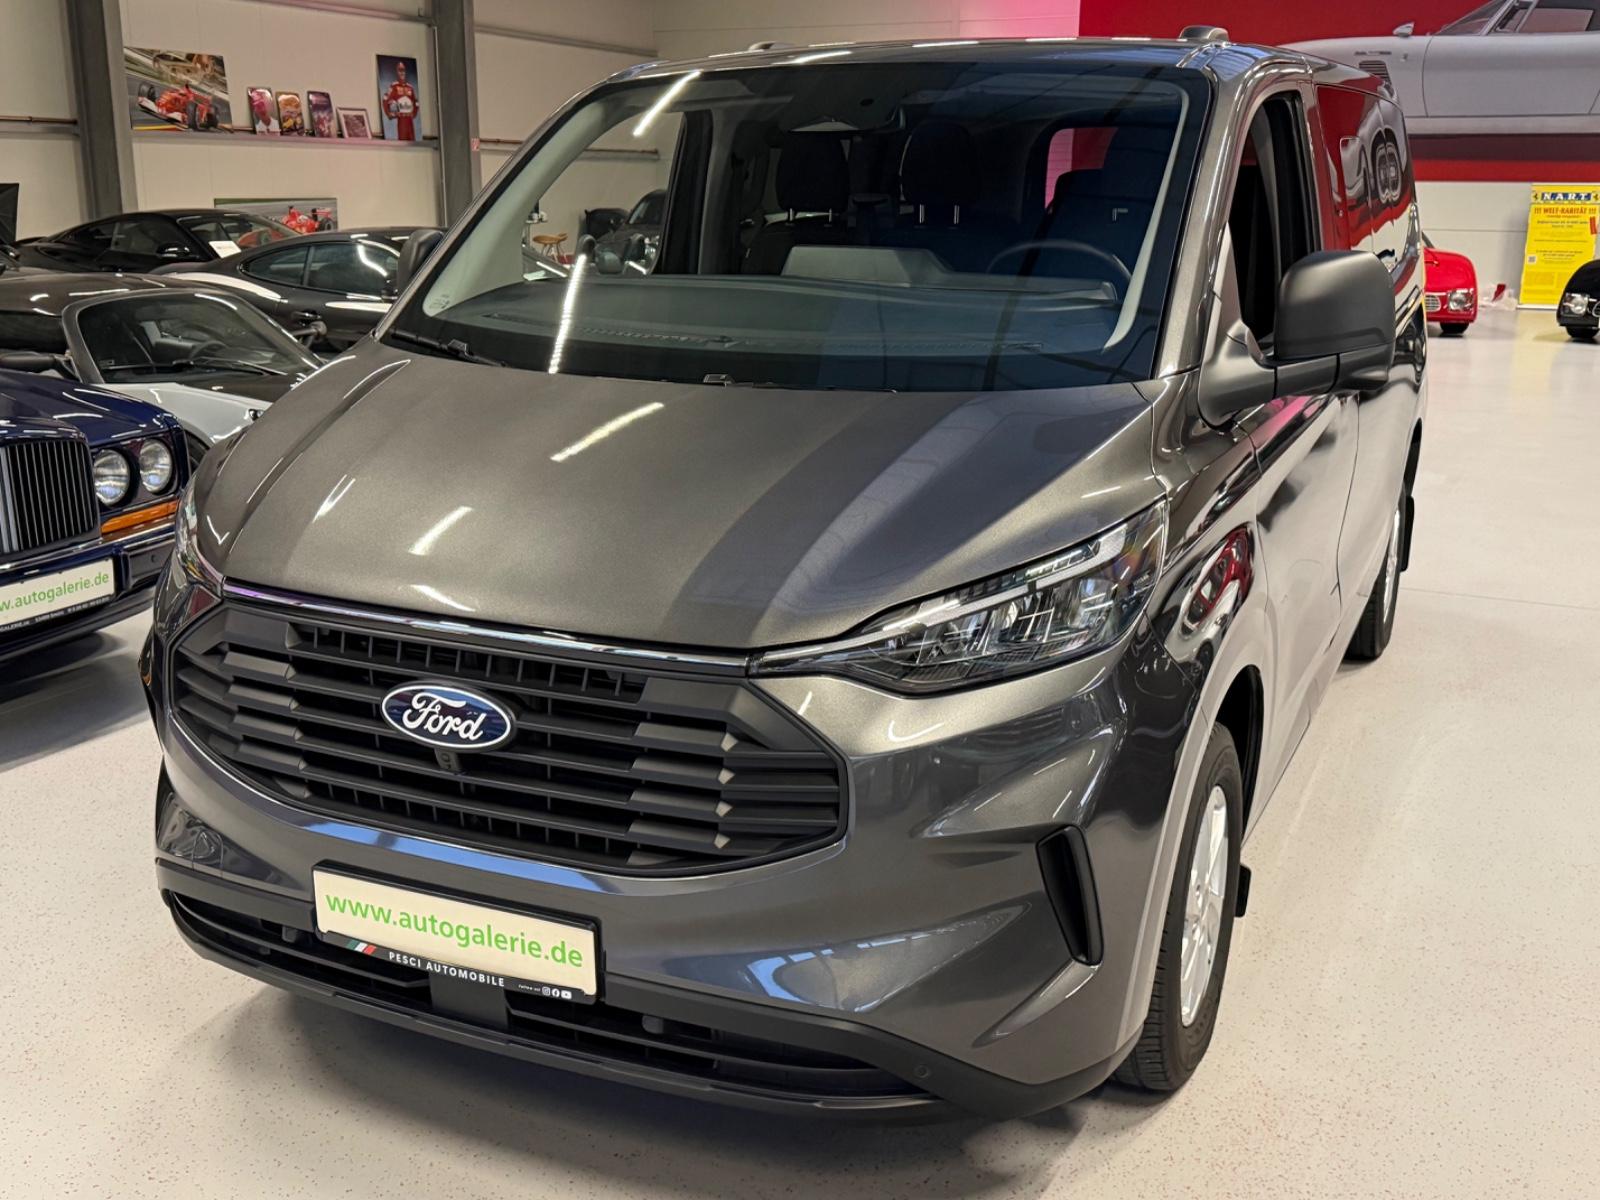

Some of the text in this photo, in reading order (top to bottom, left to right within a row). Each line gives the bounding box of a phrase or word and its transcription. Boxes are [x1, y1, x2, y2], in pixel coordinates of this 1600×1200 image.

[402, 692, 487, 741] Ford
[325, 893, 583, 967] www.autogalerie.de
[389, 951, 421, 968] PESCI
[426, 961, 505, 987] AUTOMOBILE
